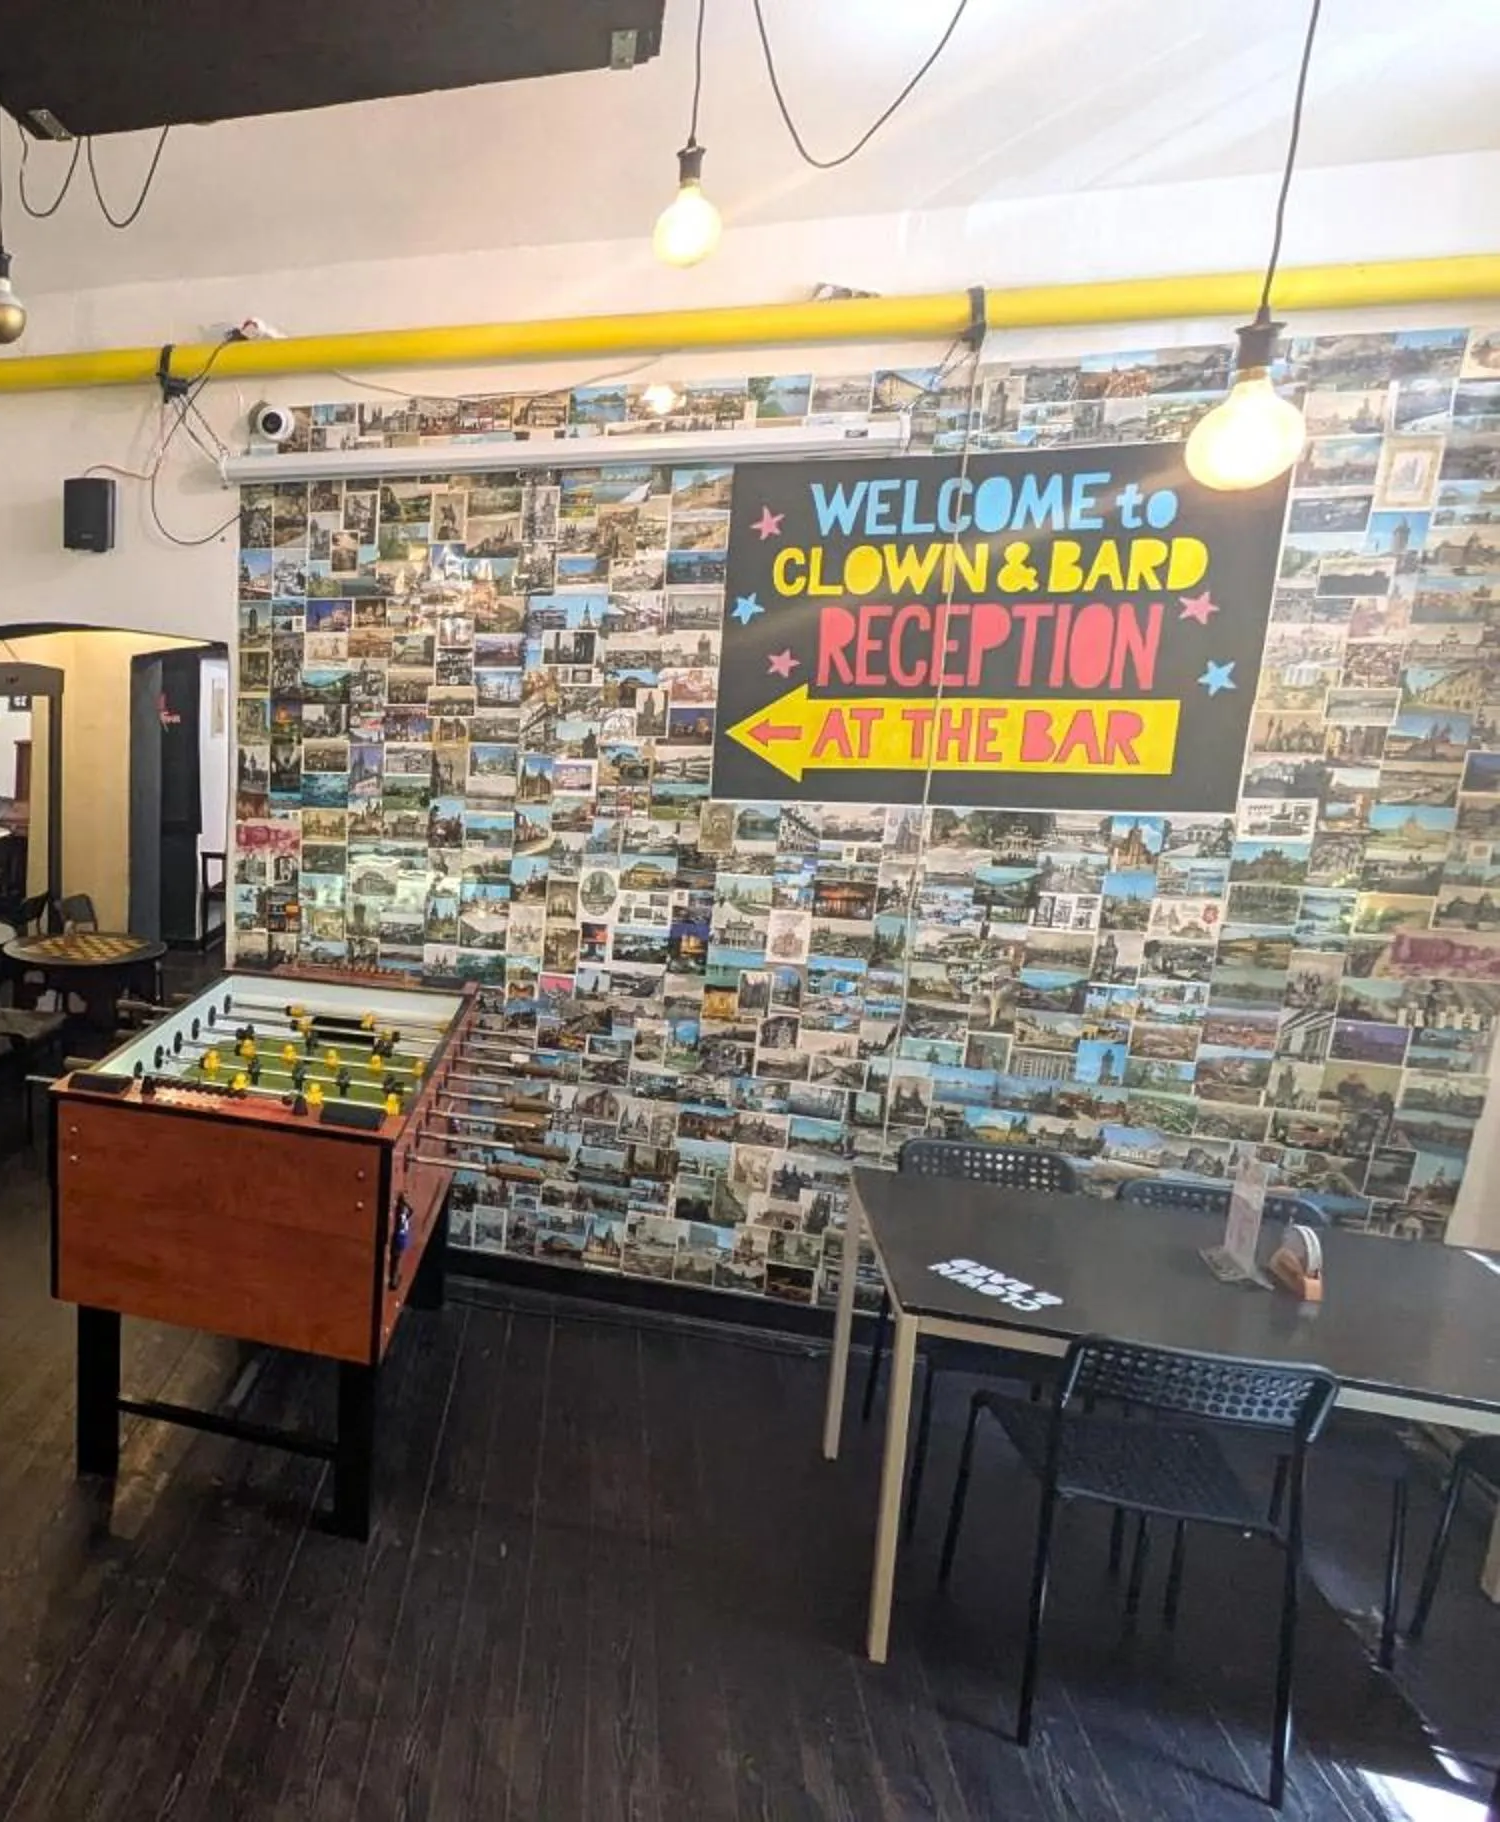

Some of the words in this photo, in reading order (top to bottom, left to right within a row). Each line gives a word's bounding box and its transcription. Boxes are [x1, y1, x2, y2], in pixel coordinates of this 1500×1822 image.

[811, 470, 1113, 536] WELCOME
[1116, 483, 1180, 529] to
[773, 541, 990, 597] CLOWN
[996, 537, 1040, 592] &
[1047, 537, 1209, 592] BARD
[815, 602, 1165, 691] RECEPTION
[810, 708, 886, 759] AT
[901, 708, 1008, 763] THE
[1020, 710, 1144, 766] BAR
